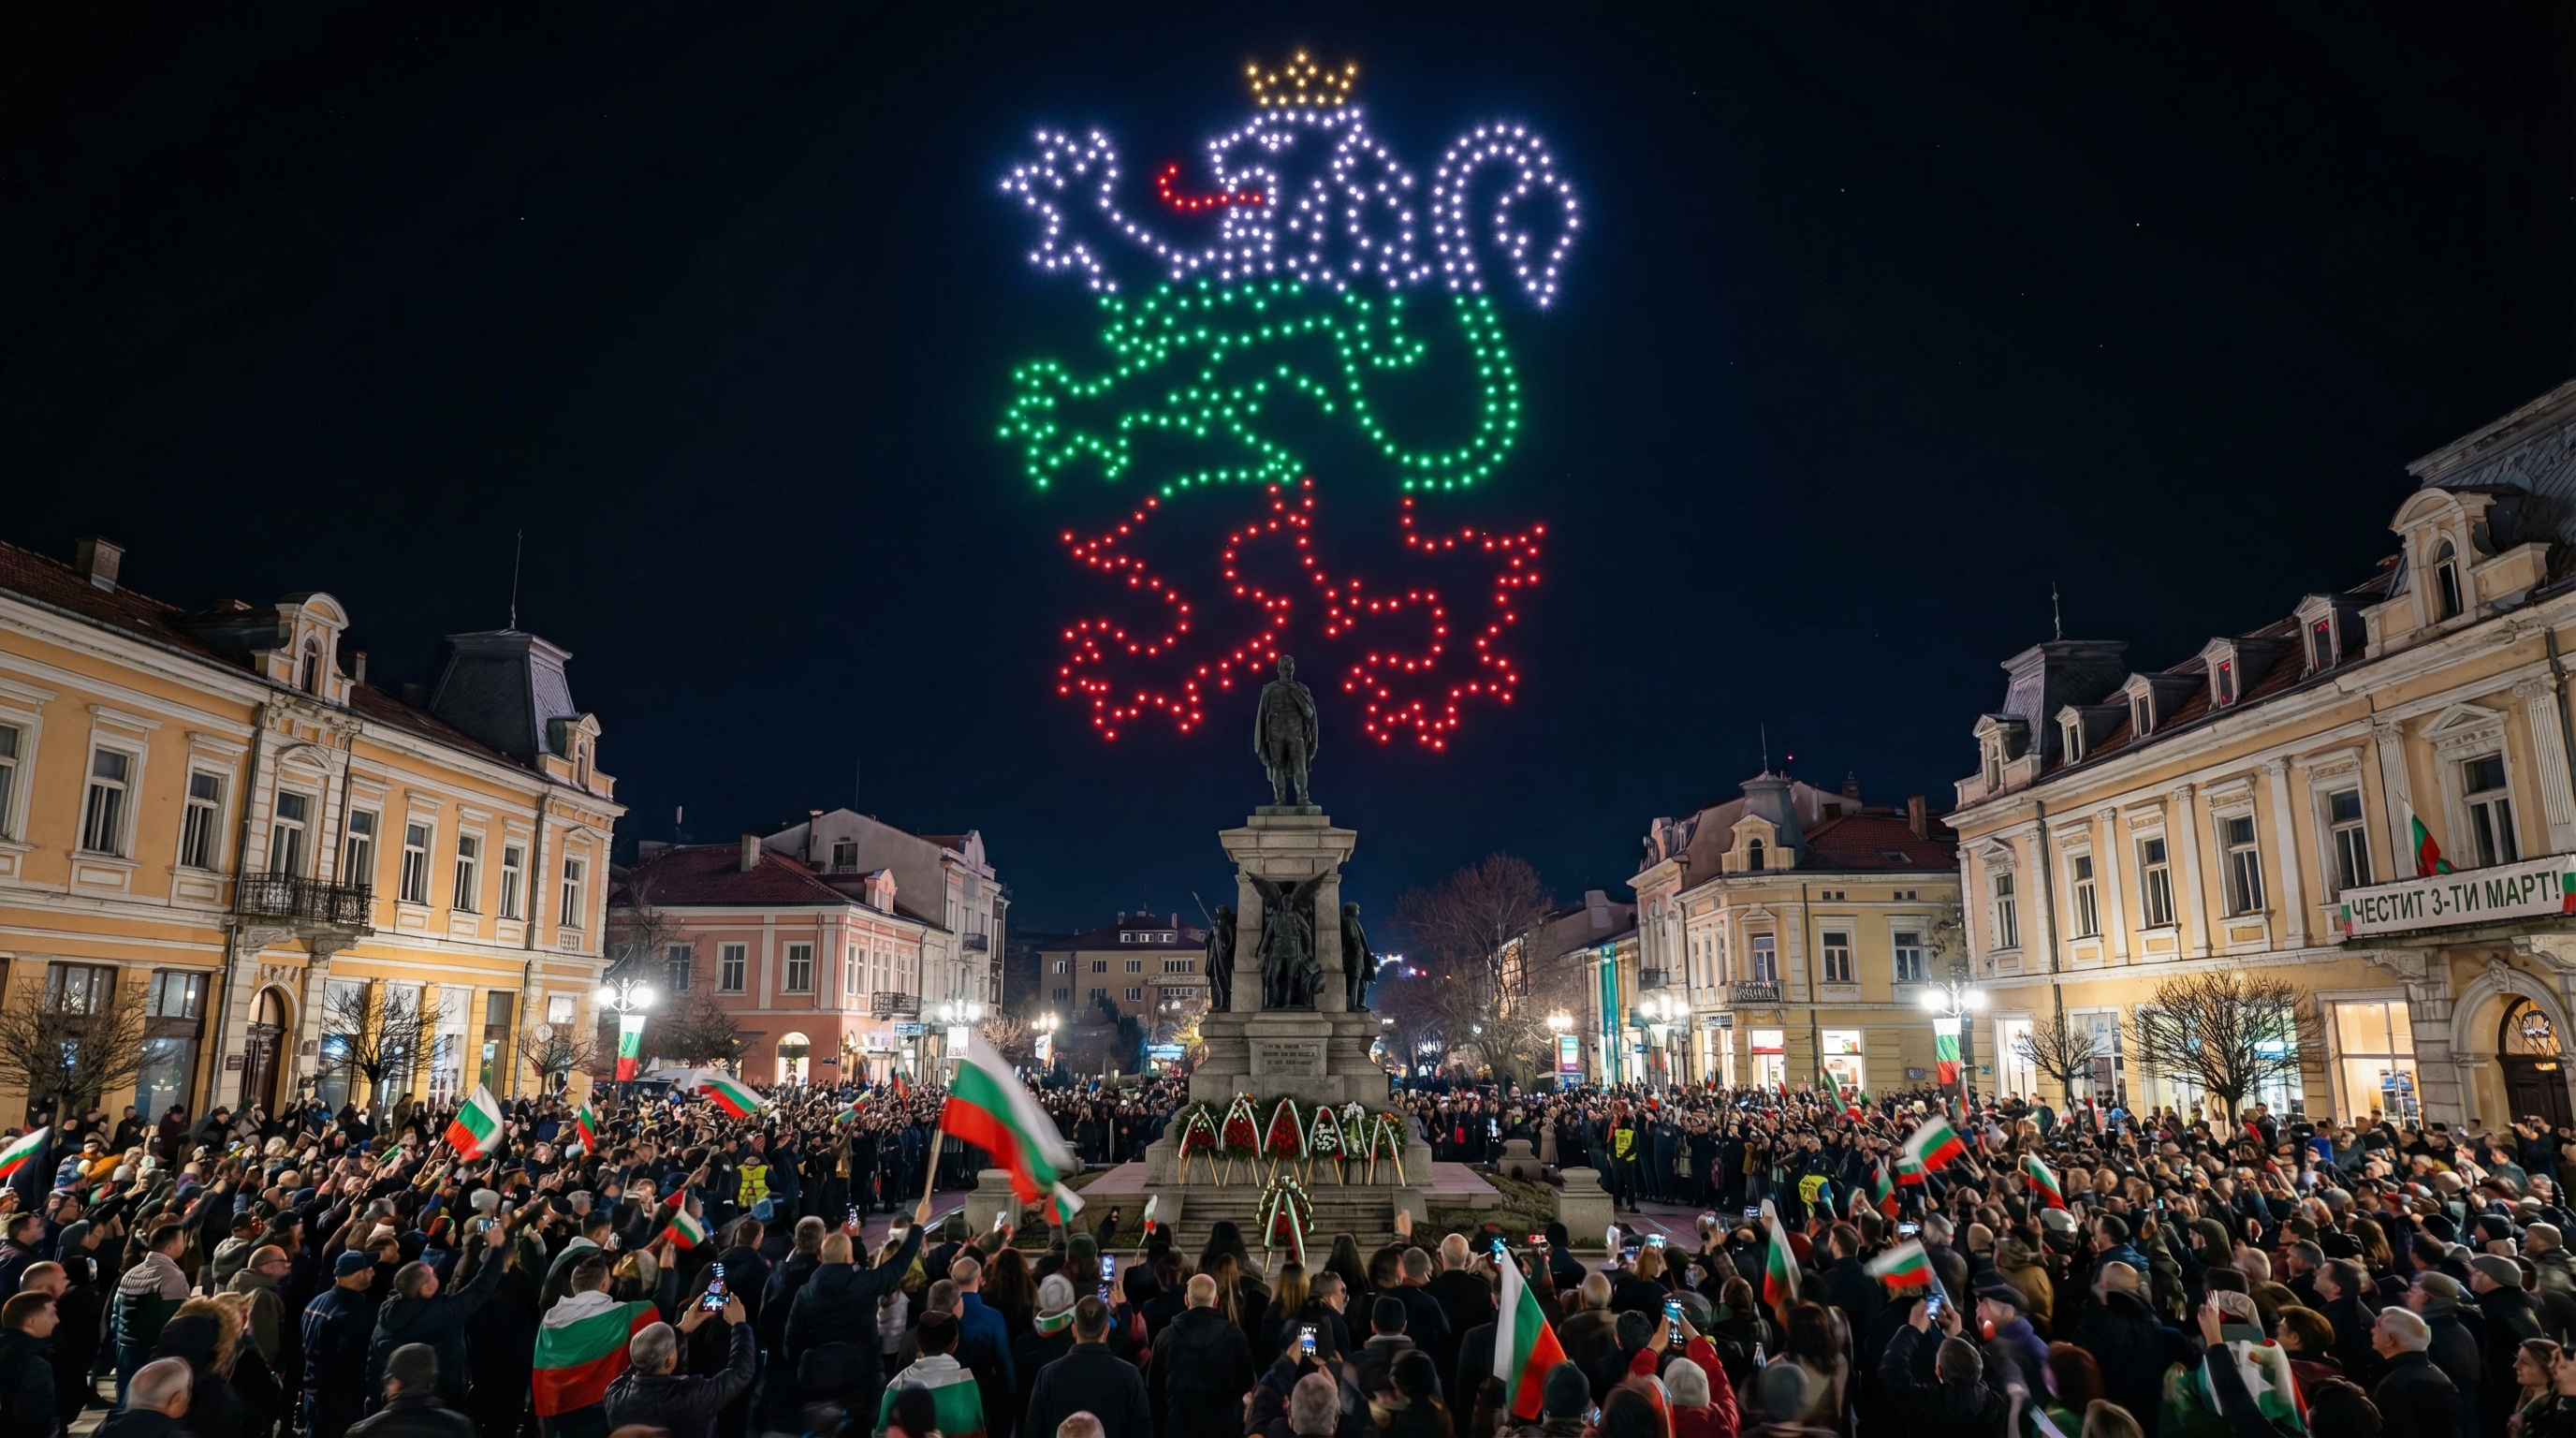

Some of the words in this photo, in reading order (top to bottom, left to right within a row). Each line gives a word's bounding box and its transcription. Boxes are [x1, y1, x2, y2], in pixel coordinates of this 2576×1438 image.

[2352, 890, 2425, 924] ЧЕСТИТ
[2431, 883, 2480, 917] 3-ТИ
[2485, 870, 2560, 909] МАРТ!
